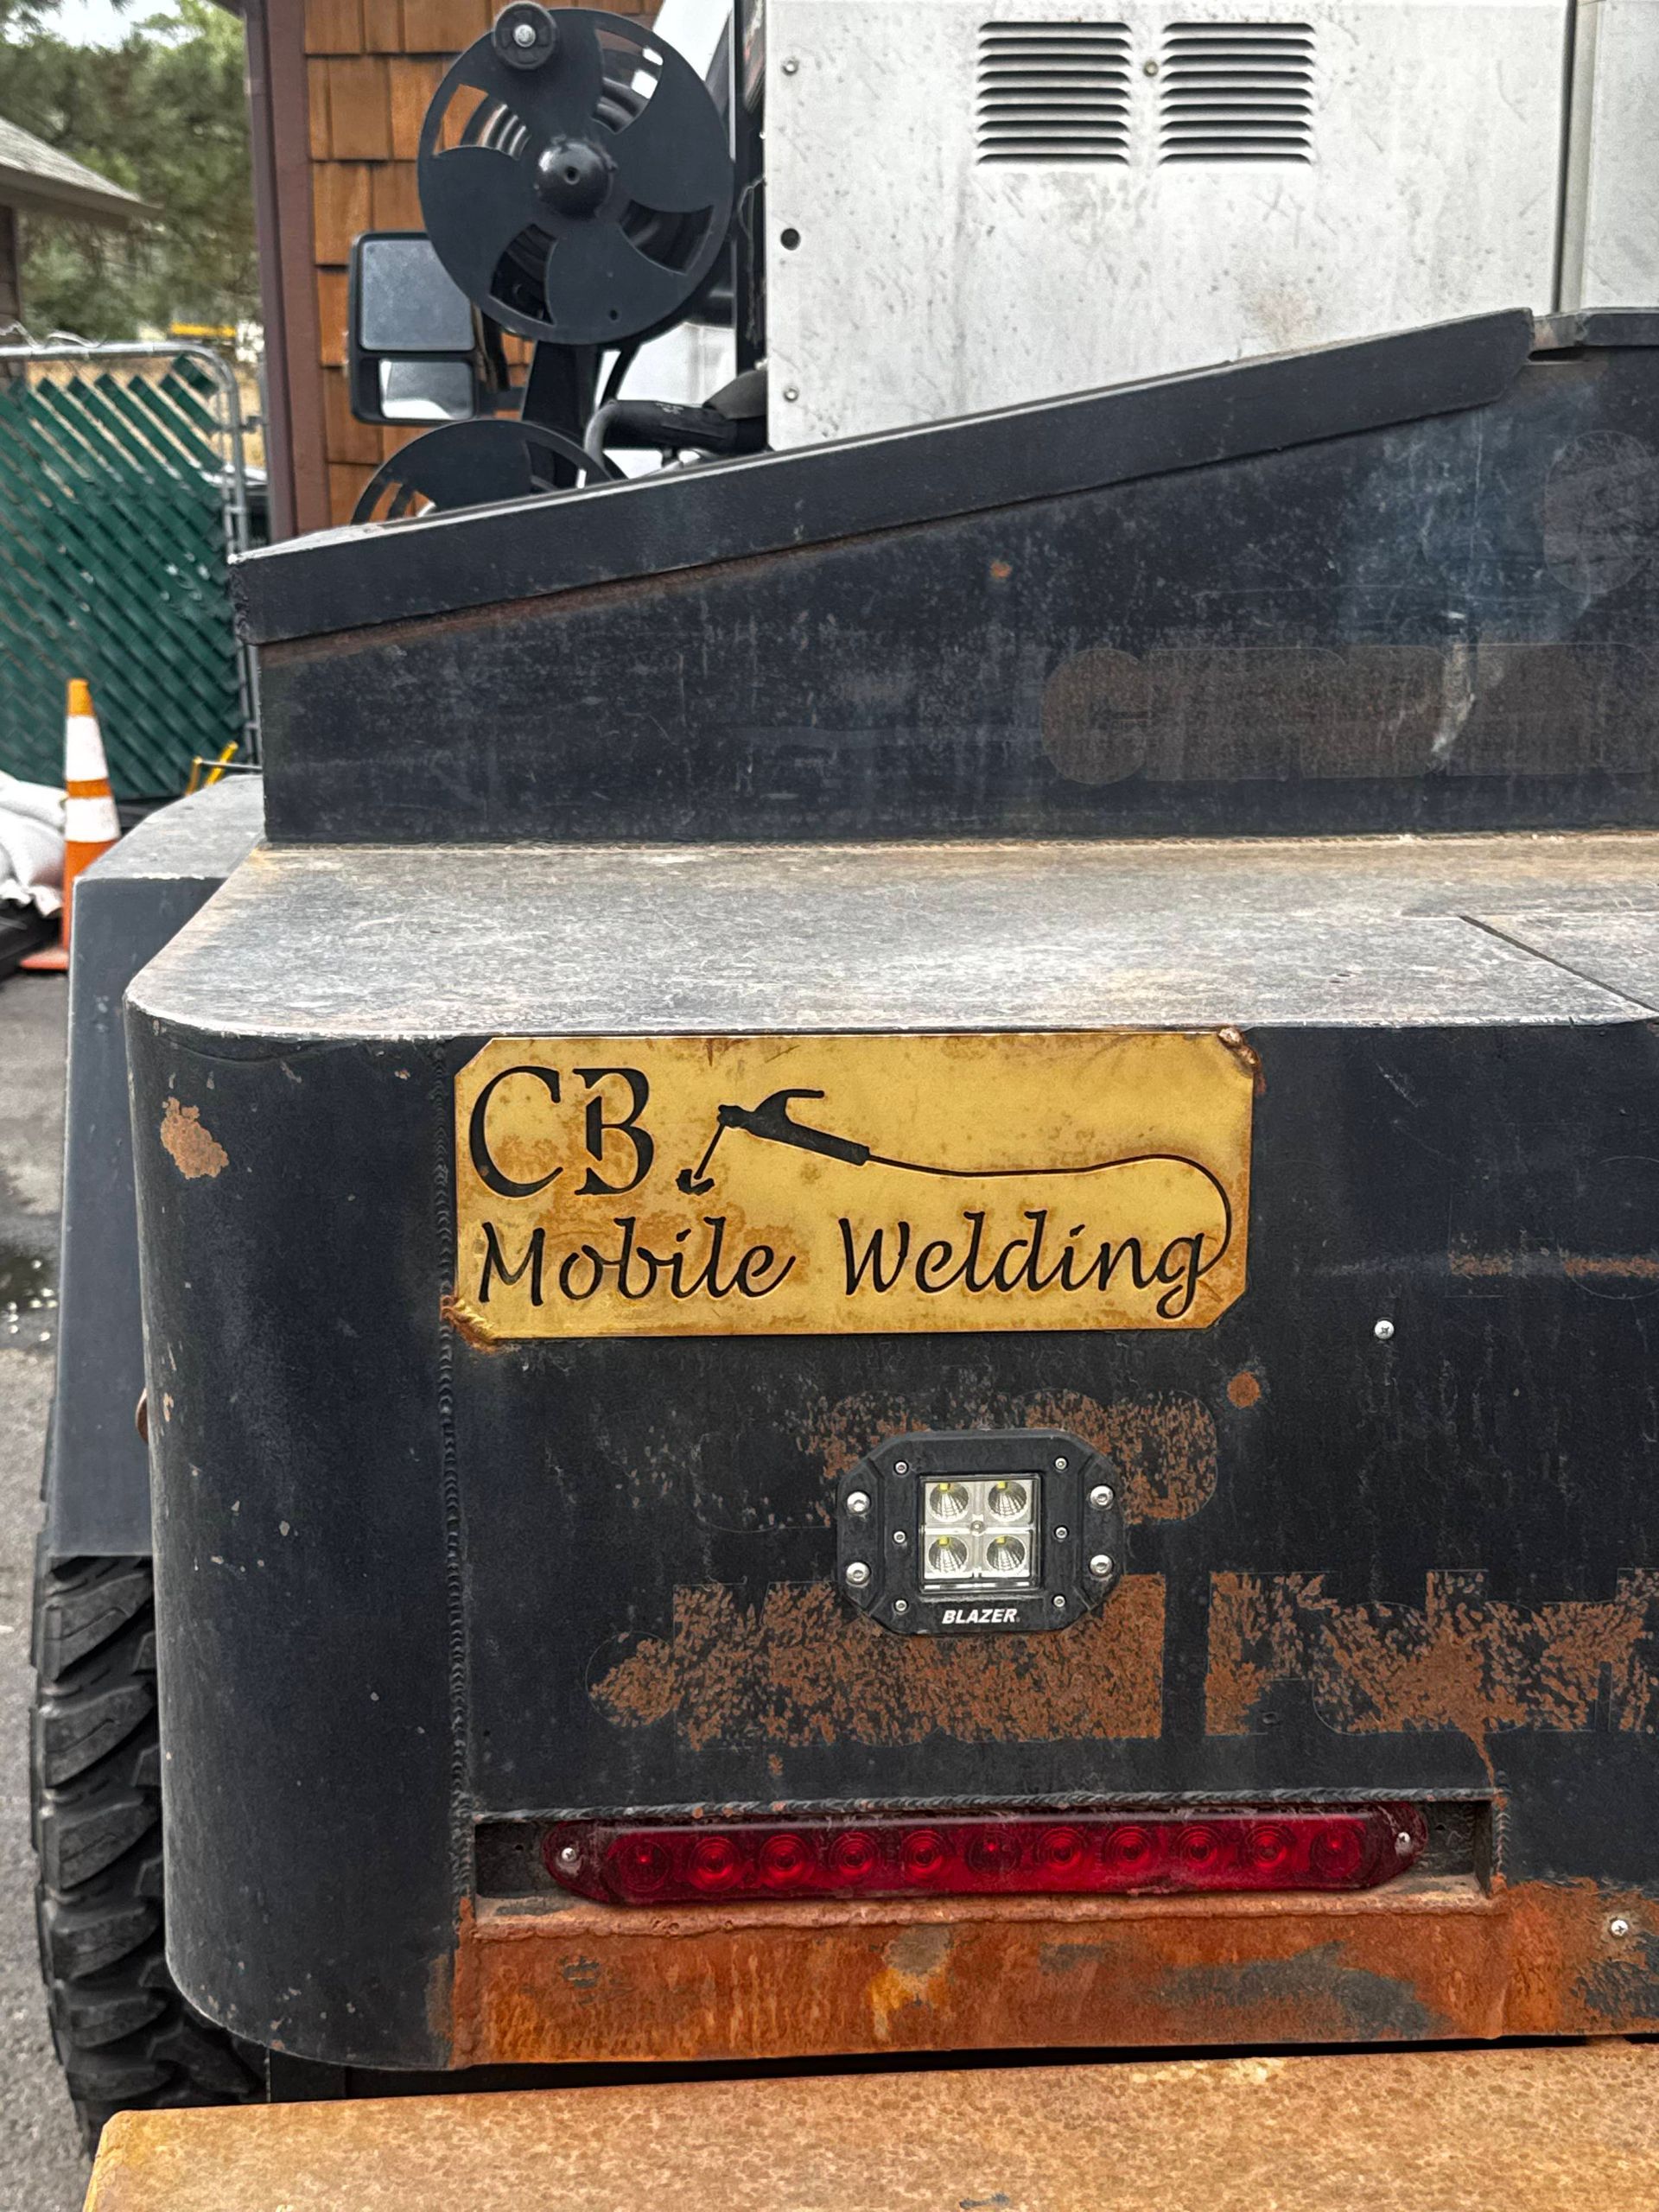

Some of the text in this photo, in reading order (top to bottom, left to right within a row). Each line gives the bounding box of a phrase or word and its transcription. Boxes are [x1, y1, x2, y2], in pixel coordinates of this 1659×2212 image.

[467, 1065, 656, 1200] CB
[477, 1210, 1213, 1319] Mobile Welding
[941, 1608, 1018, 1624] BLAZER
